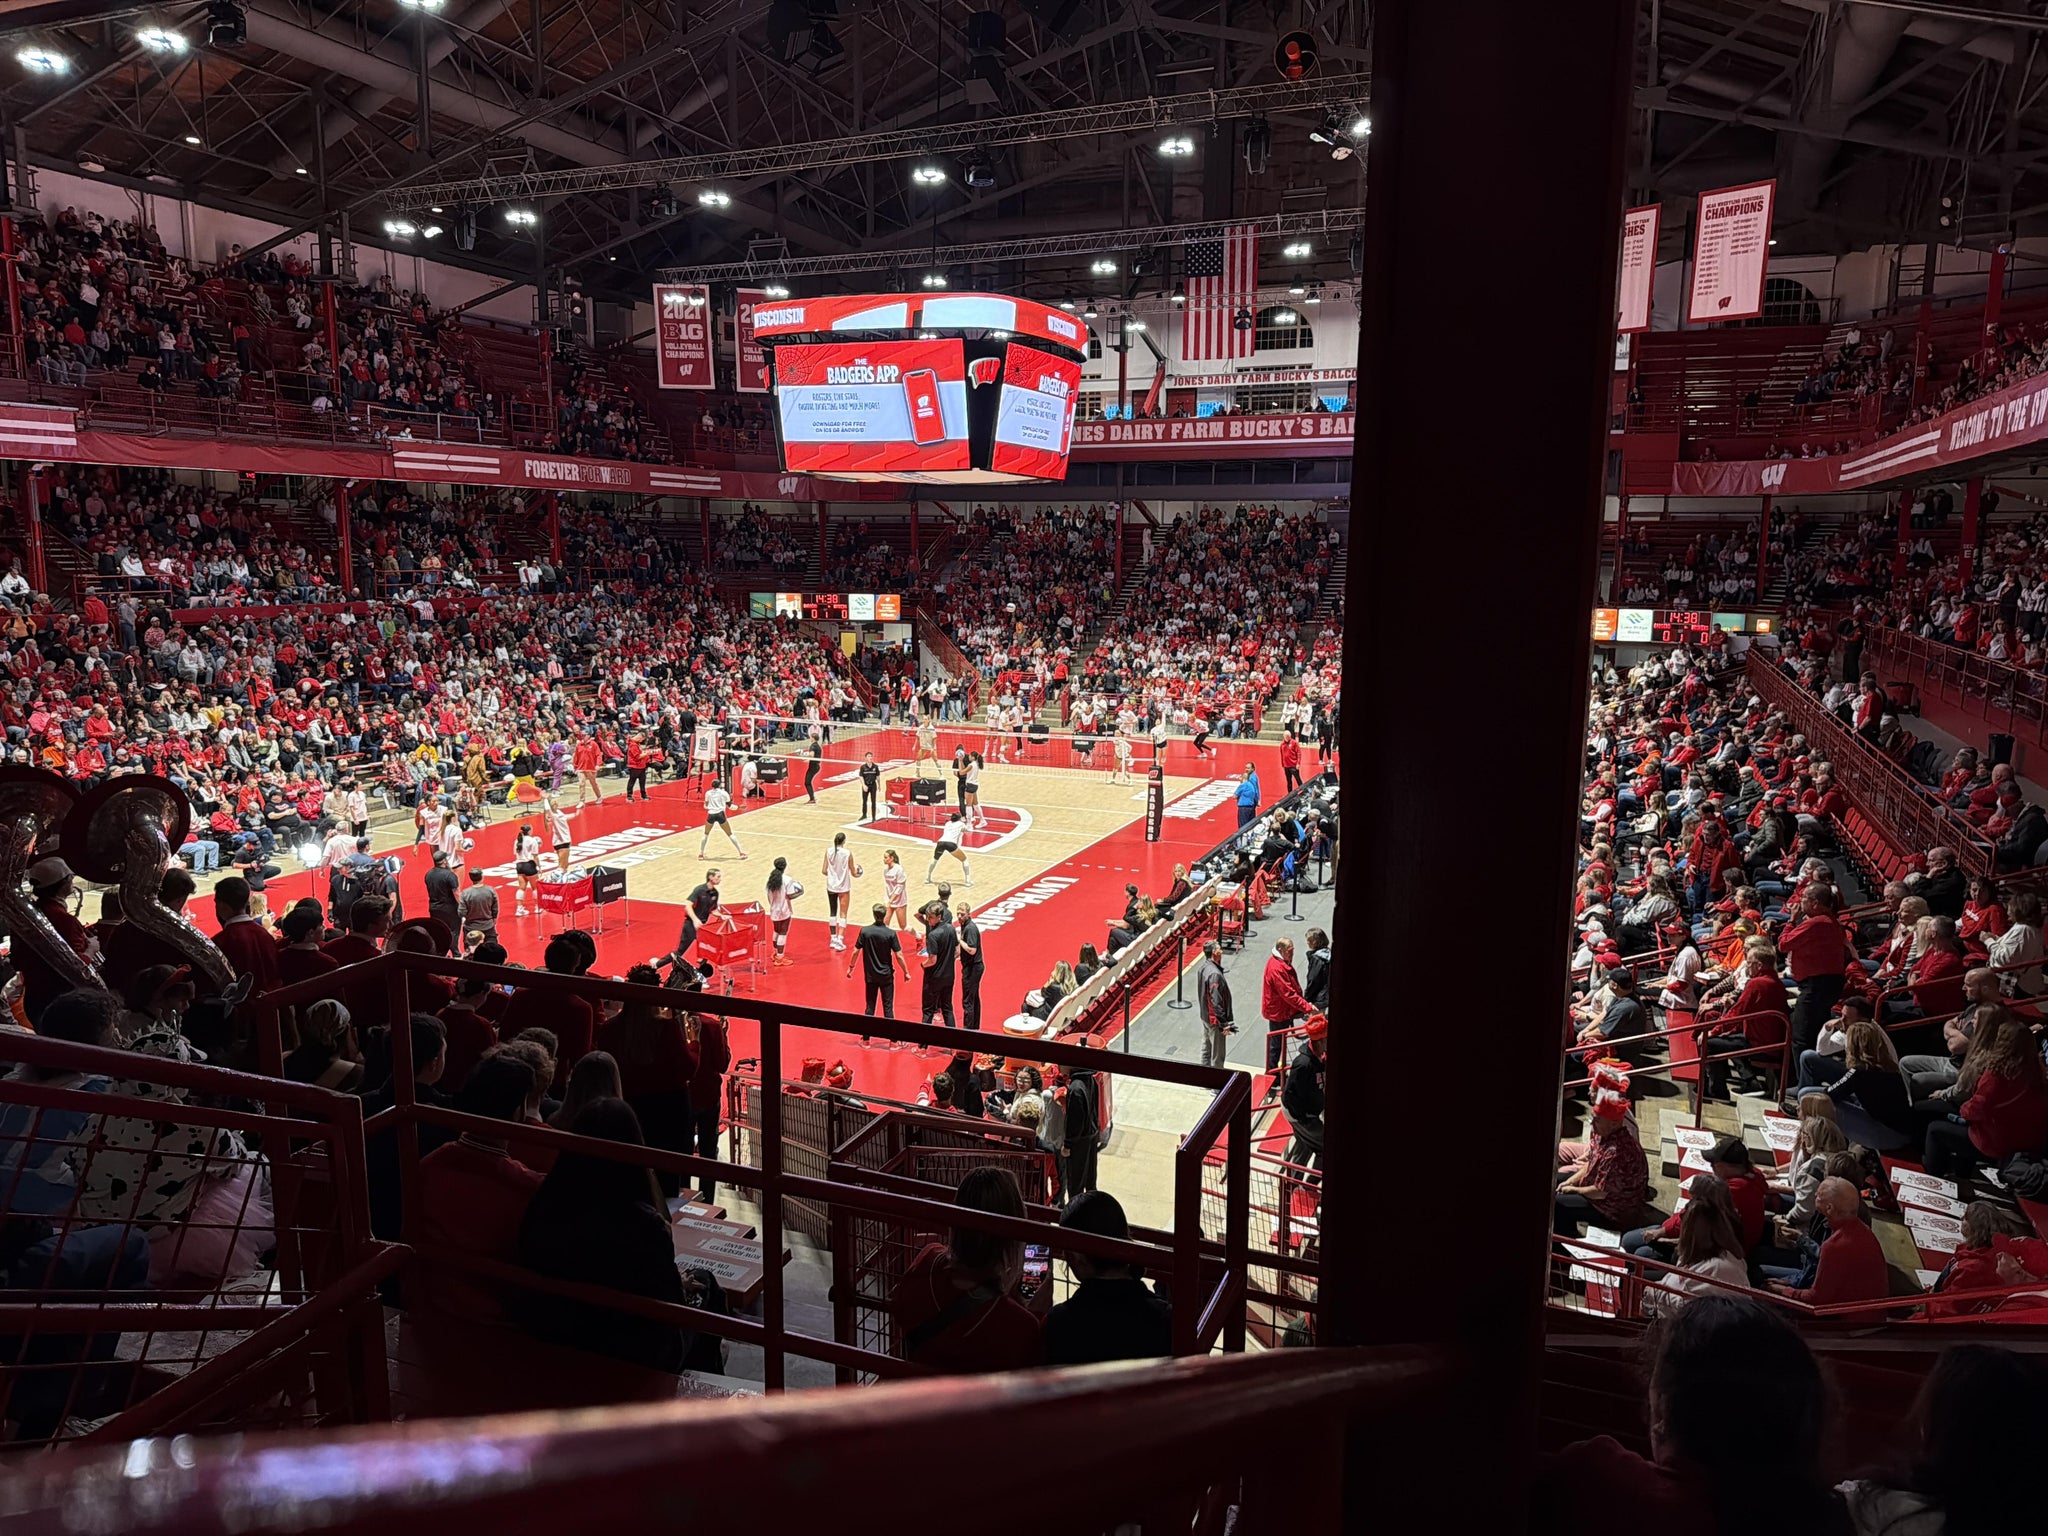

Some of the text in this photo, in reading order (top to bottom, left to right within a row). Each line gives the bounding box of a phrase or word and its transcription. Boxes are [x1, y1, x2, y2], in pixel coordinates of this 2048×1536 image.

[1705, 200, 1764, 221] CHAMPIONS
[663, 299, 702, 320] 2021
[664, 342, 705, 351] VOLLEYBALL
[665, 351, 705, 359] CHAMPIONS
[854, 358, 868, 366] THE
[827, 365, 899, 385] BADGERS APP
[1173, 376, 1204, 387] JONES
[1207, 374, 1240, 386] DAIRY
[1241, 372, 1273, 384] FARM
[1274, 370, 1320, 383] BUCKY'S
[1110, 424, 1166, 441] DAIRY
[1171, 422, 1224, 439] FARM
[1229, 416, 1314, 438] BUCKY'S
[1948, 409, 1990, 452] WELCOME
[1989, 403, 2005, 440] TO
[2005, 394, 2031, 435] THE
[524, 459, 632, 485] FOREVER FORWARD
[1963, 549, 1972, 559] E
[815, 594, 838, 604] 14:38
[1670, 612, 1698, 624] 14:38
[709, 1244, 744, 1257] RESERVED
